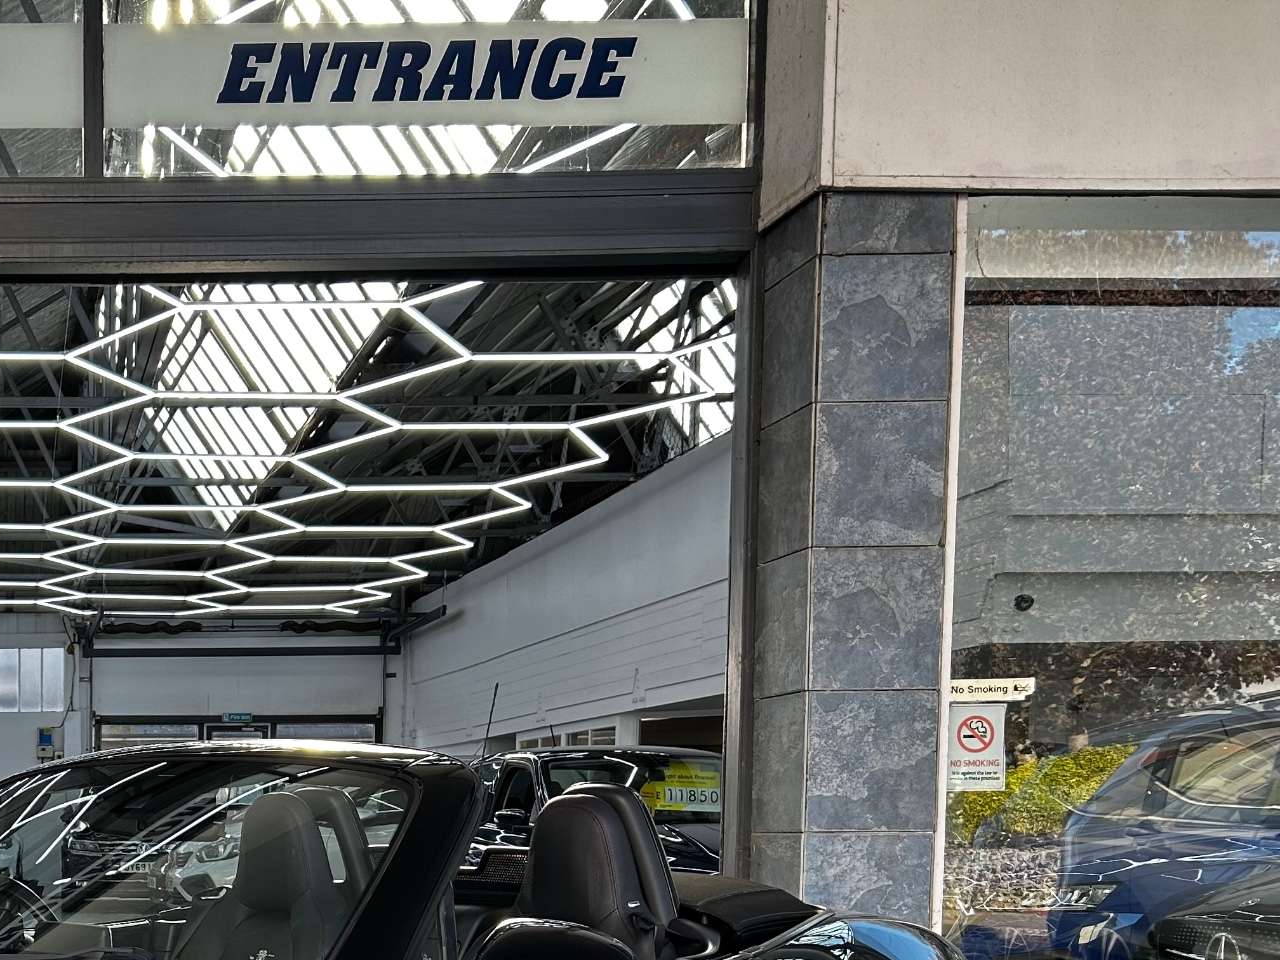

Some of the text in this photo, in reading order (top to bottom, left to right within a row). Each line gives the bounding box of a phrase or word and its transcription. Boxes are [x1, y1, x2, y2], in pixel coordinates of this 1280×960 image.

[216, 37, 638, 103] ENTRANCE
[951, 685, 1008, 694] No Smoking
[950, 760, 962, 768] NO
[668, 788, 719, 803] 11850
